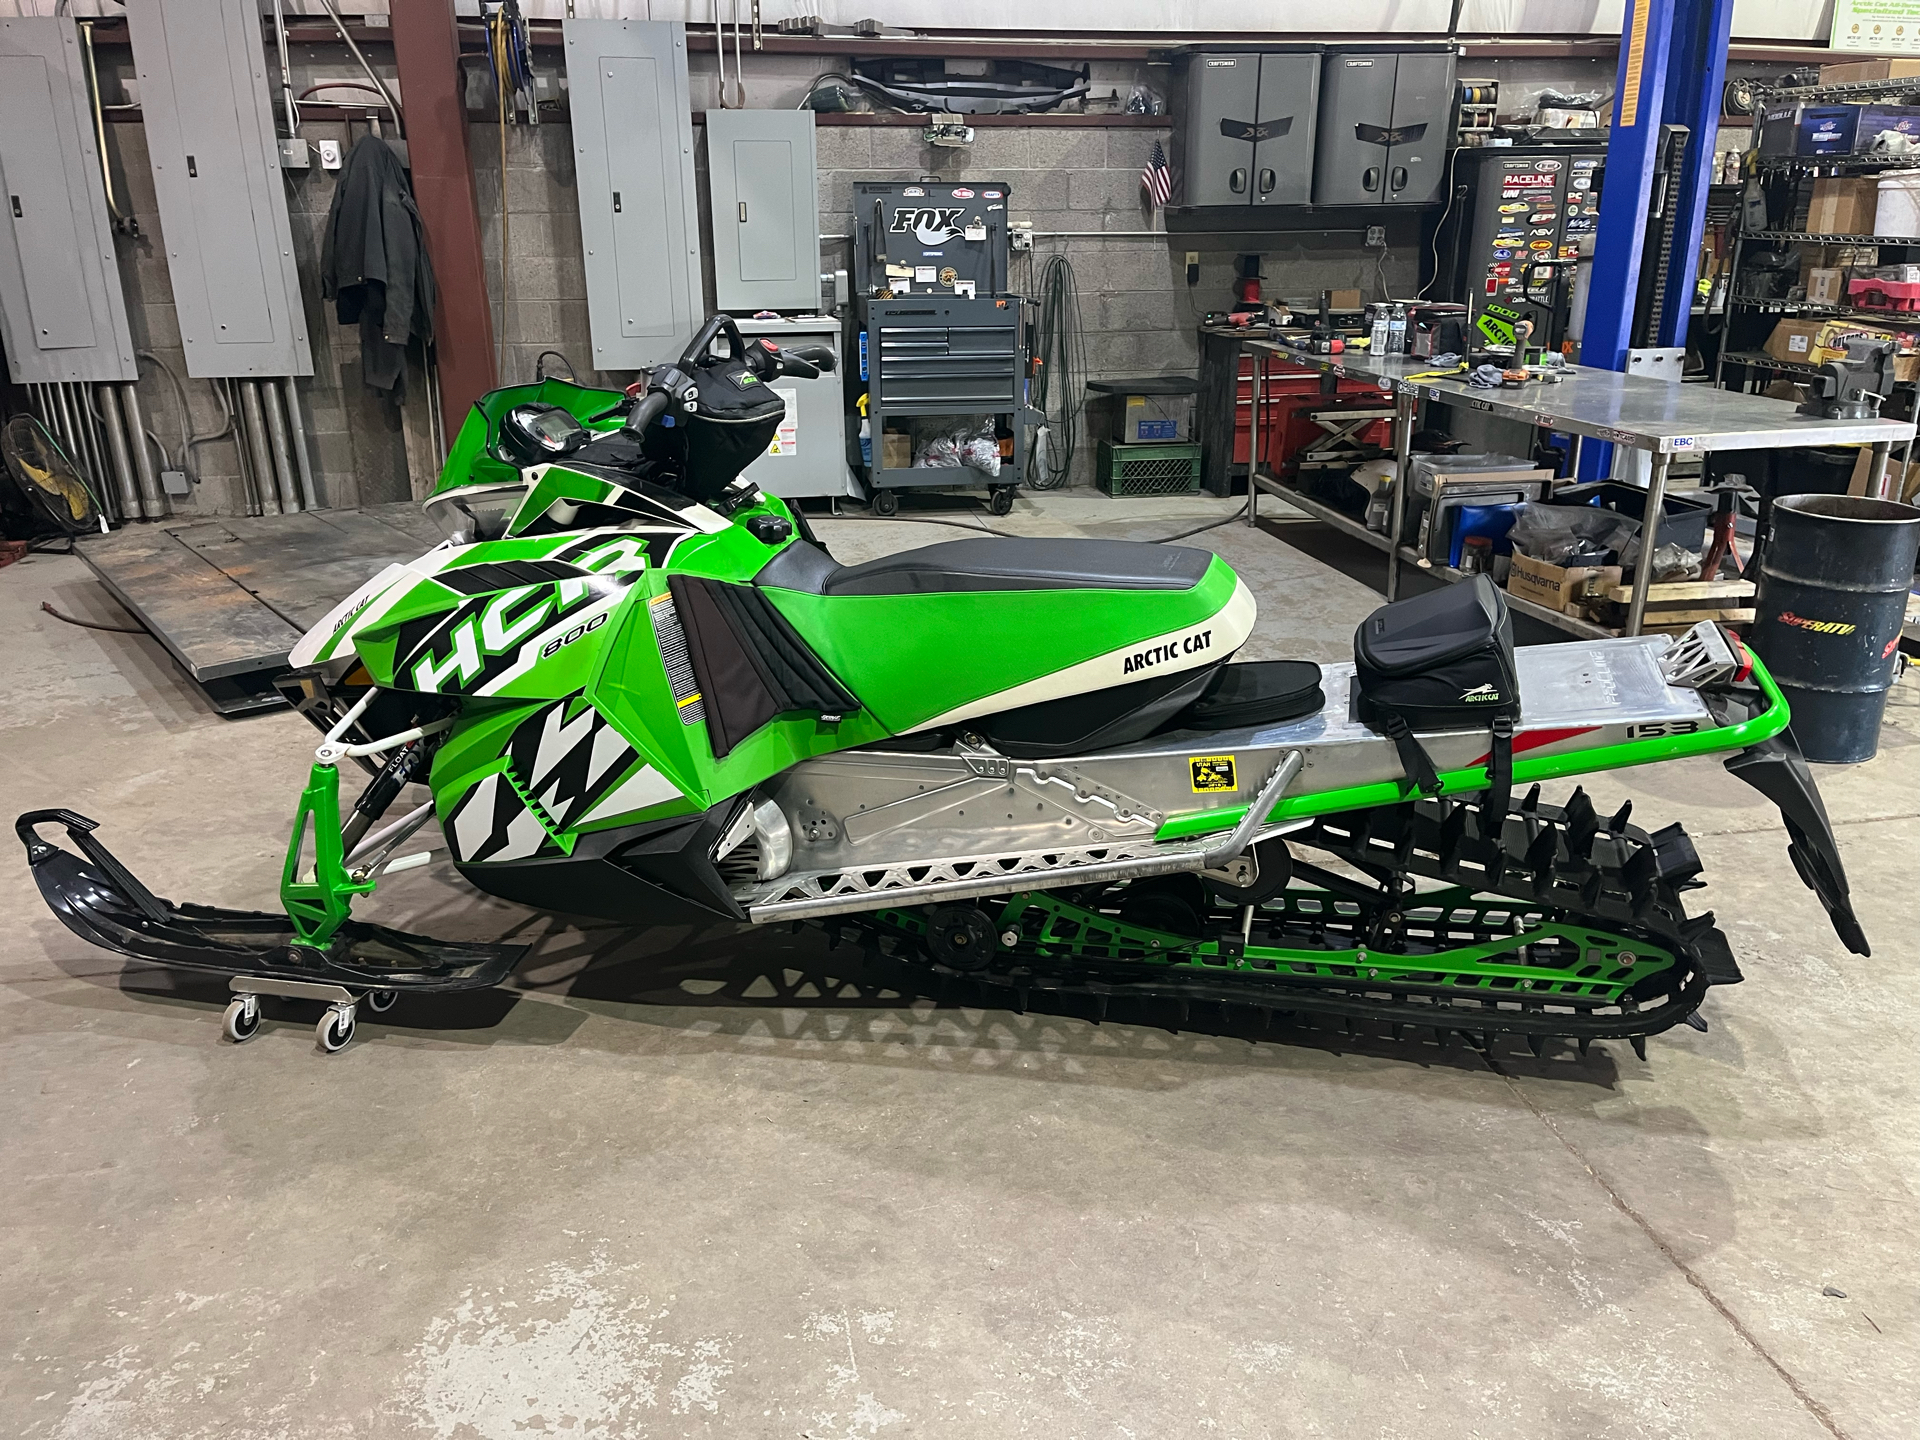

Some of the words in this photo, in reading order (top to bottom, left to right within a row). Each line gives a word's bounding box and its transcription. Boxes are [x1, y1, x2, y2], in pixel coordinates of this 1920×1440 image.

[1505, 175, 1553, 183] RACELINE
[1502, 189, 1519, 198] UNI
[889, 208, 966, 236] FOX
[1530, 213, 1556, 222] EPI
[1530, 228, 1554, 236] ASV
[1486, 303, 1520, 319] 1000
[1674, 437, 1693, 446] EBC
[1517, 568, 1561, 592] Husqvarna
[333, 605, 356, 634] ARCTIC
[356, 593, 370, 611] CAT
[411, 534, 652, 693] HCR
[1778, 611, 1857, 636] SUPERATV
[541, 611, 609, 660] 800
[1123, 641, 1179, 675] ARCTIC
[1183, 629, 1212, 655] CAT
[1626, 721, 1699, 738] 153
[388, 745, 409, 773] FLOAT
